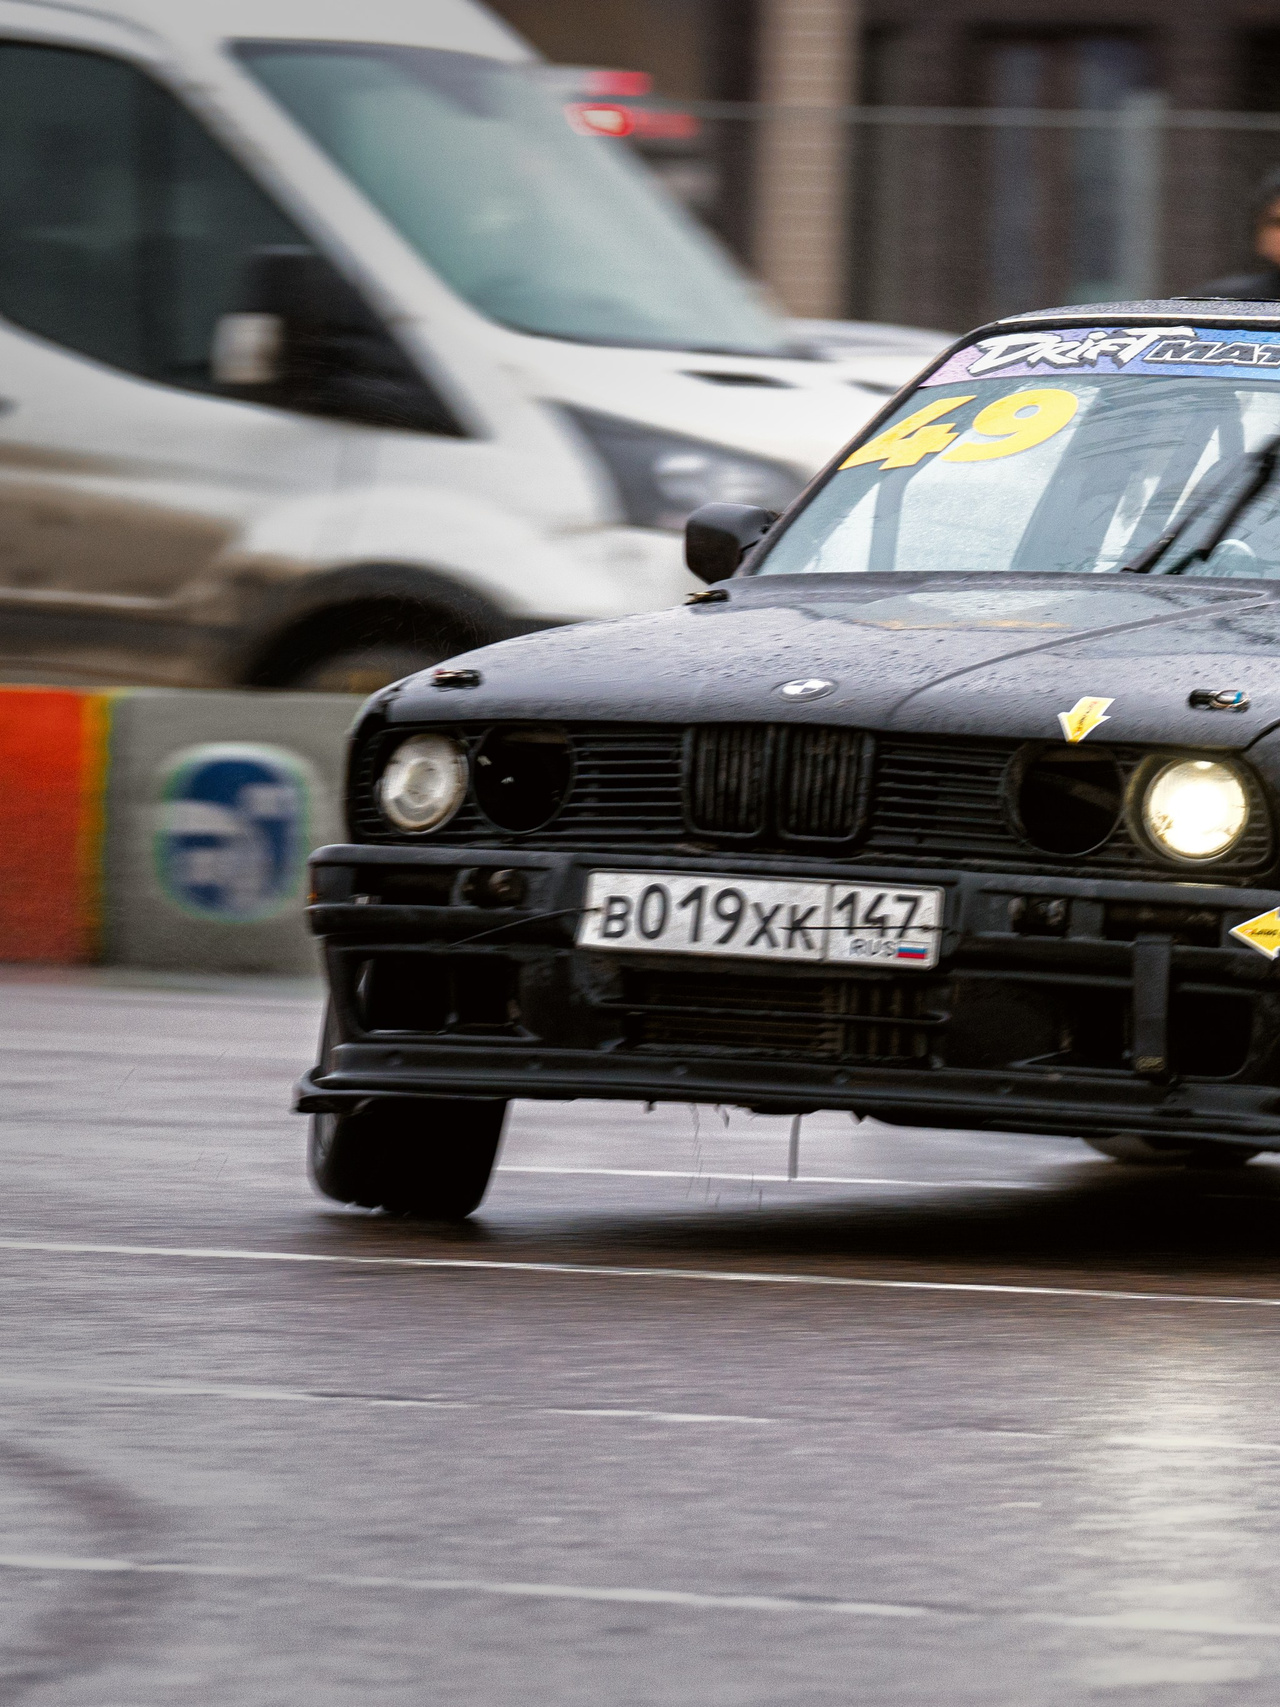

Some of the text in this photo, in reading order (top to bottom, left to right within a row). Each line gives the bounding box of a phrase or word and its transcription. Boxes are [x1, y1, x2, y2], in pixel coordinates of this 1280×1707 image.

[837, 388, 1079, 470] 49
[835, 890, 924, 938] 147
[849, 937, 897, 959] RUS
